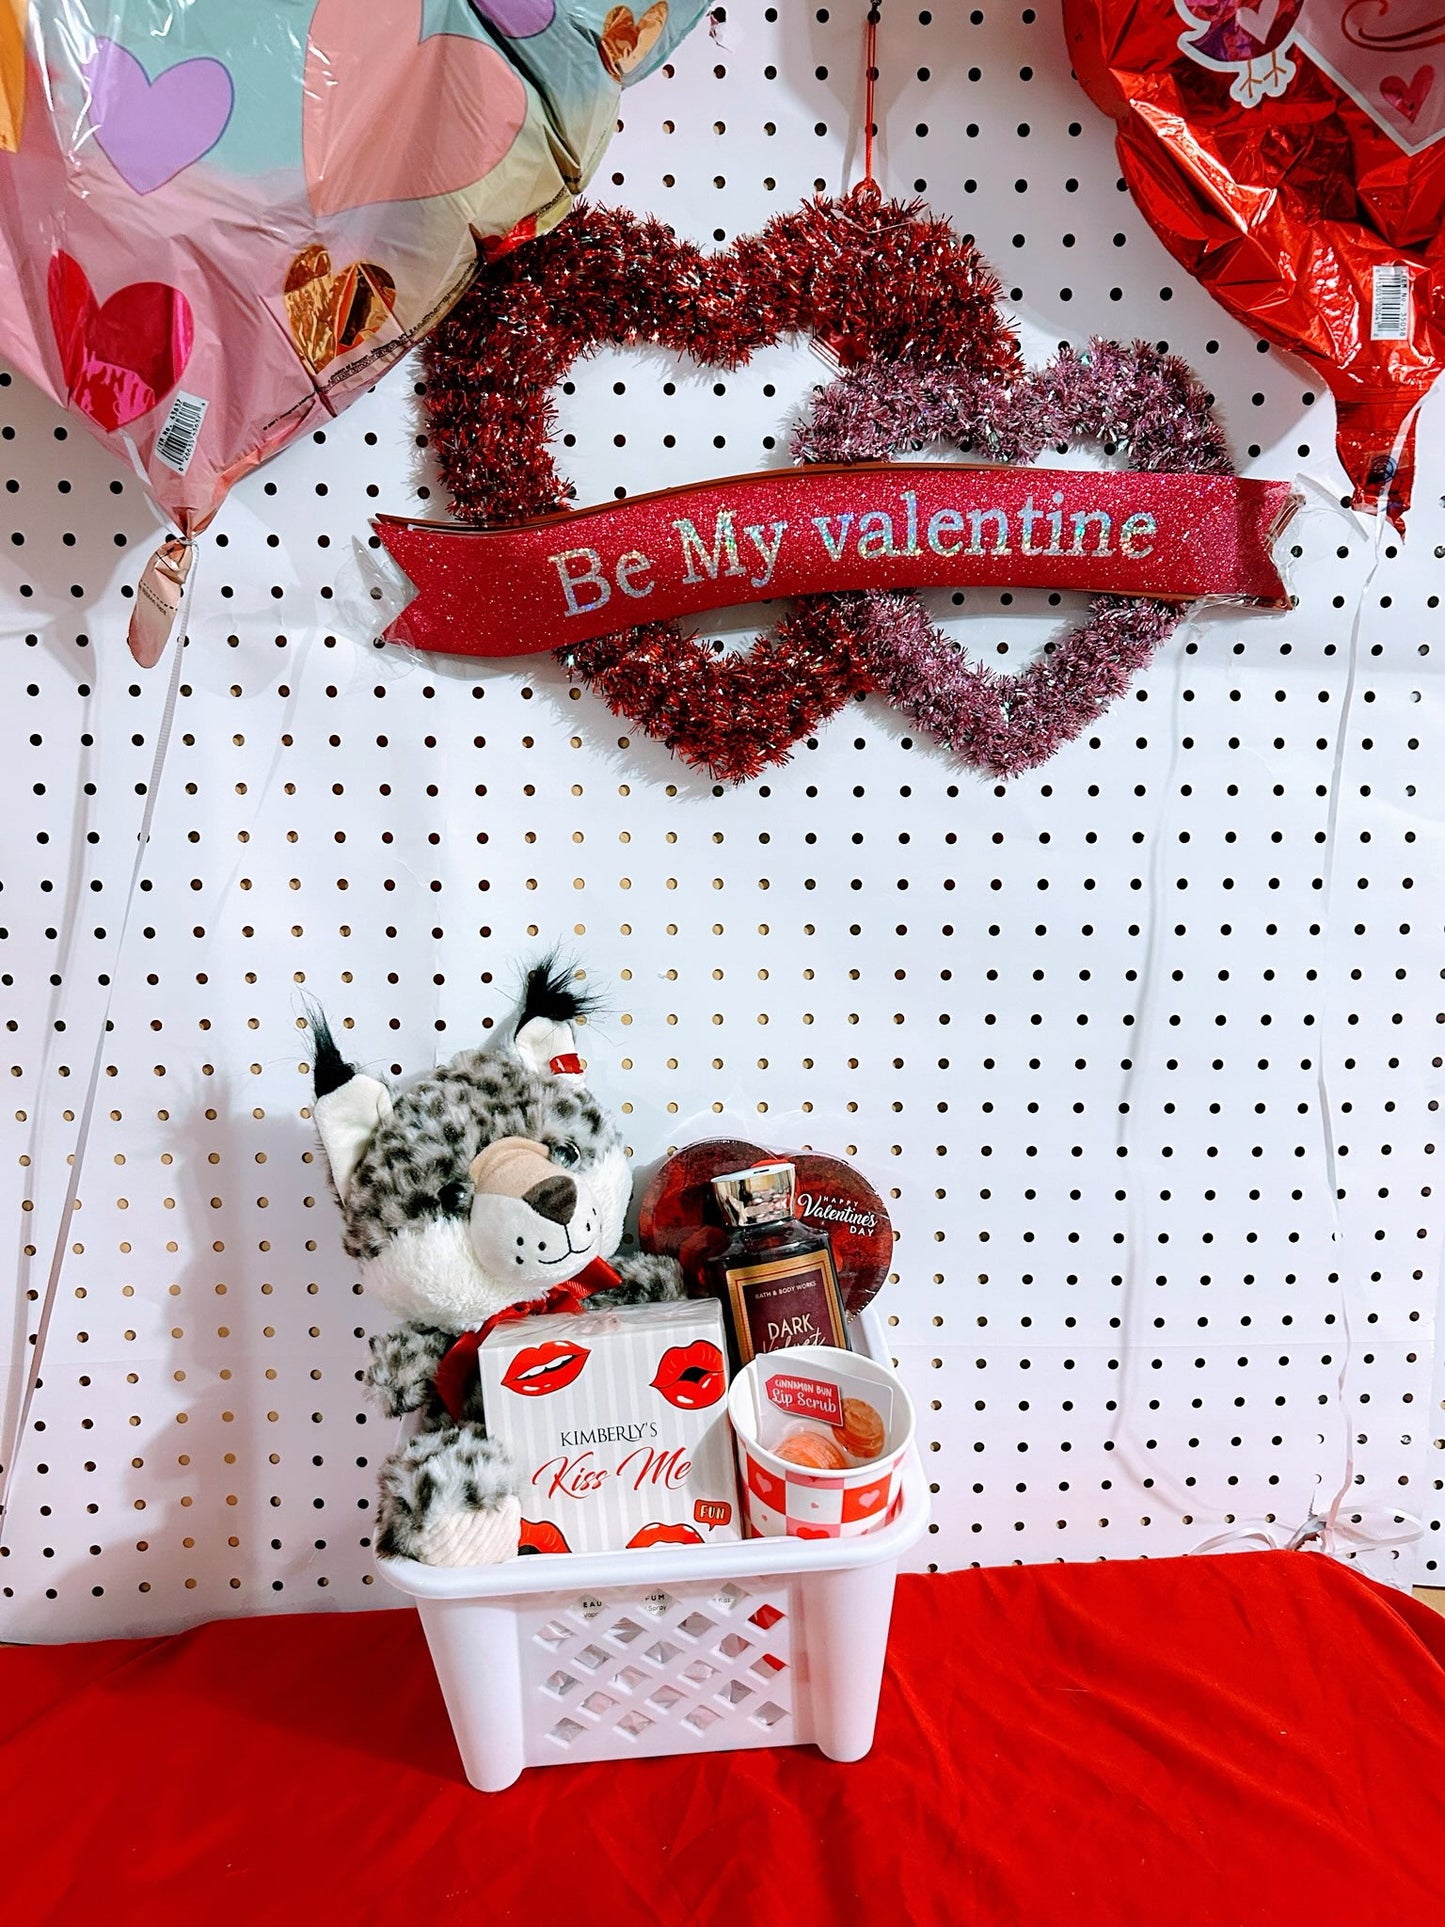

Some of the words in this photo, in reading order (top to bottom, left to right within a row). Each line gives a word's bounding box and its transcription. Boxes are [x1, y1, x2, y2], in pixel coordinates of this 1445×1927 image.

[548, 547, 655, 618] Be
[672, 509, 788, 587] My
[812, 490, 1157, 563] valentine
[797, 1193, 878, 1228] Valentine's
[824, 1195, 859, 1207] HAPPY
[850, 1226, 874, 1237] DAY
[755, 1291, 772, 1299] BATH
[778, 1286, 795, 1295] BODY
[796, 1281, 817, 1290] WORKS
[767, 1313, 815, 1340] DARK
[771, 1388, 793, 1407] Lip
[797, 1392, 836, 1413] Scrub
[816, 1385, 832, 1397] BUN
[560, 1422, 658, 1447] KIMBERLY'S
[532, 1451, 611, 1499] Kiss
[616, 1446, 692, 1491] Me
[699, 1504, 725, 1520] FUN
